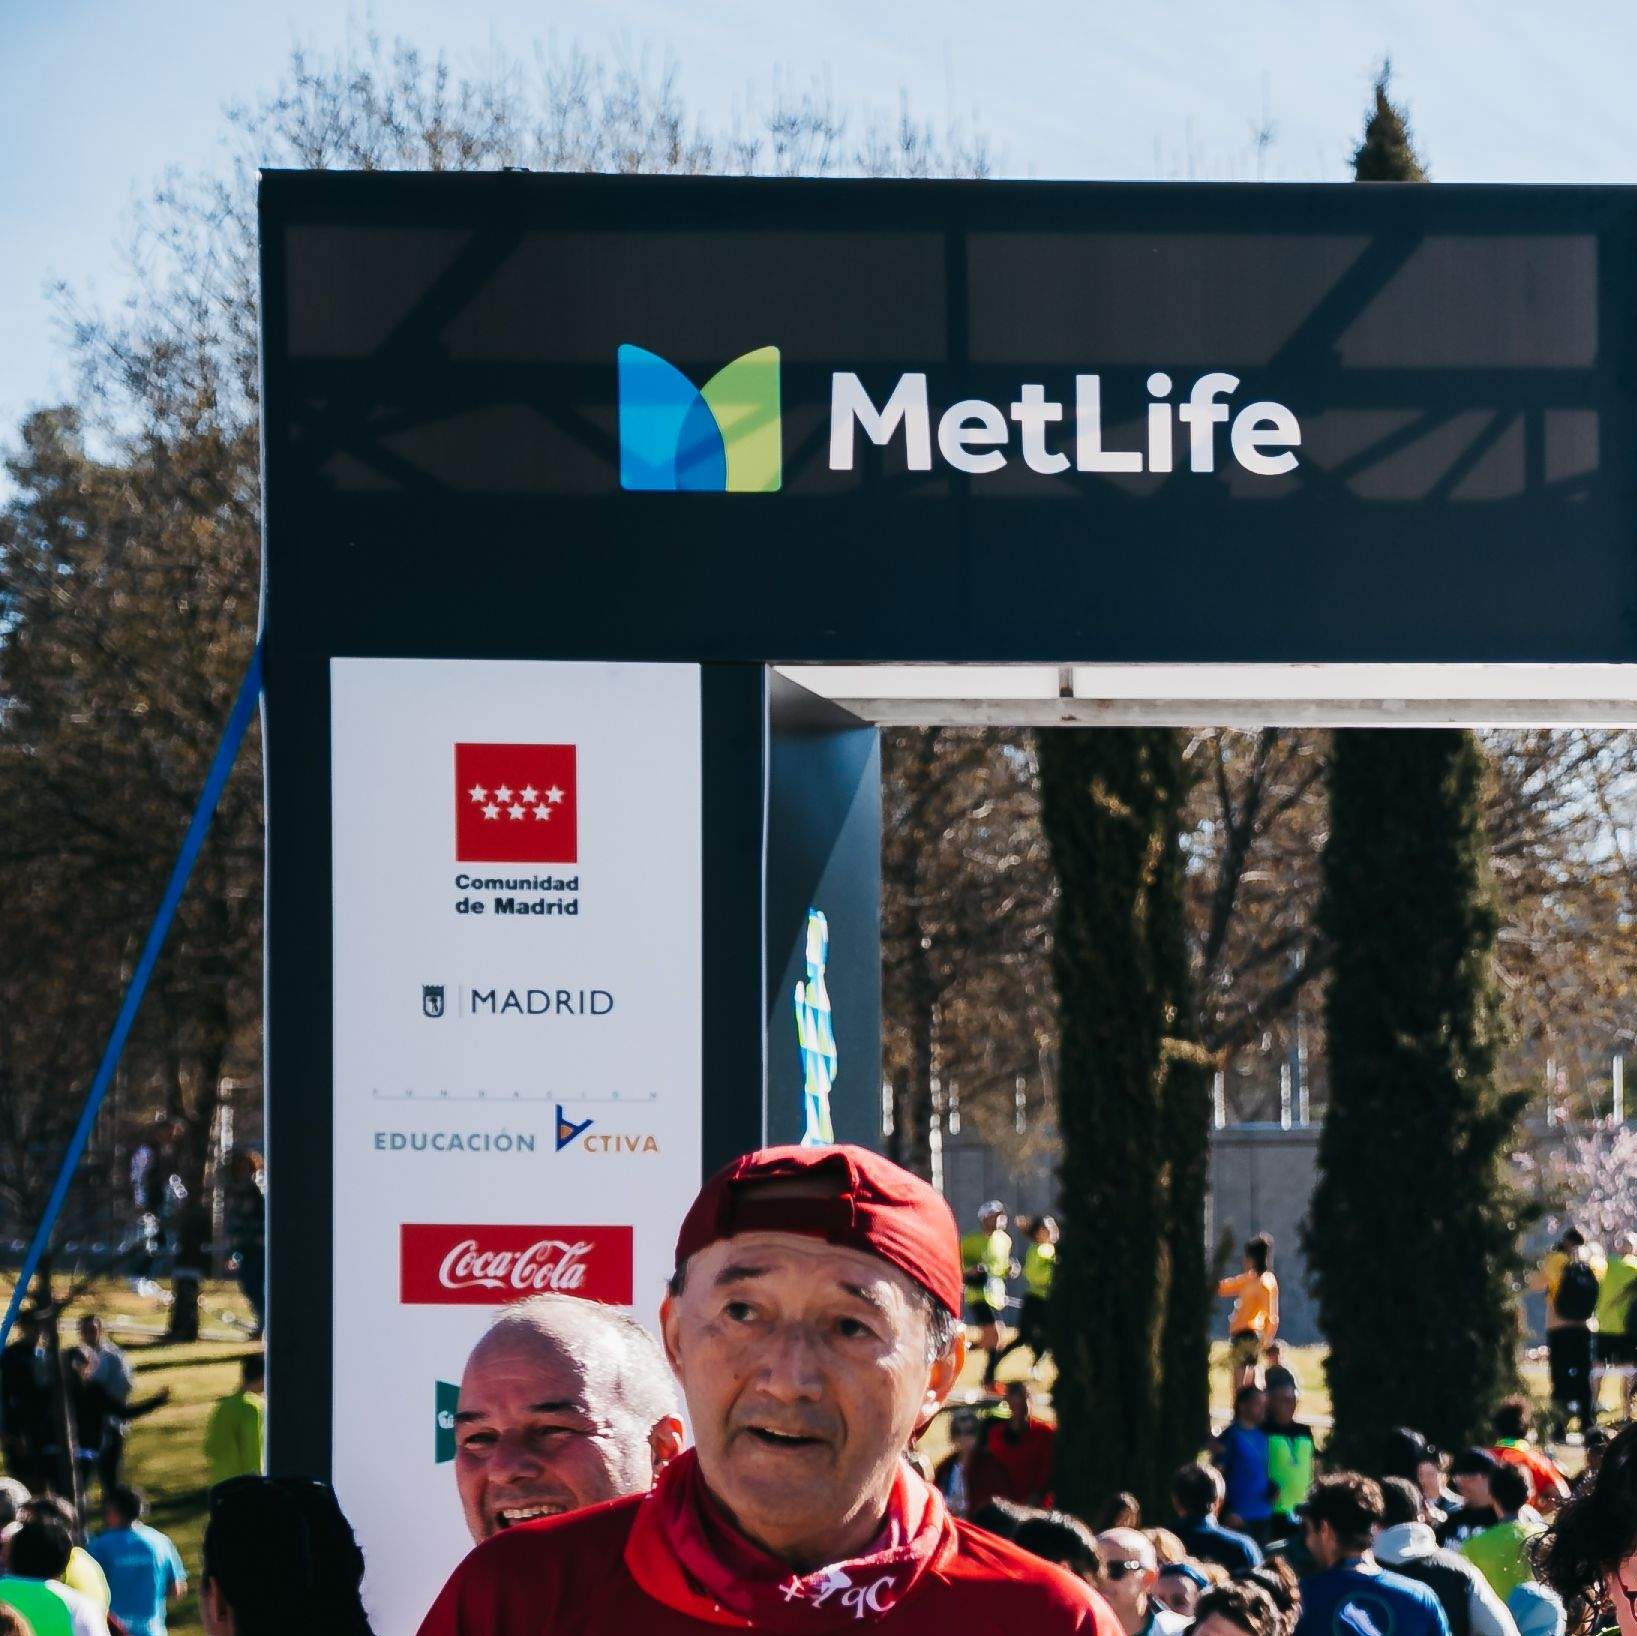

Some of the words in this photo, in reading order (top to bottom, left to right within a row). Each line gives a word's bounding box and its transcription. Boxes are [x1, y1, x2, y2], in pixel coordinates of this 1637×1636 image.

[828, 370, 1302, 476] MetLife
[454, 873, 580, 892] Comunidad
[454, 897, 485, 915] de
[494, 897, 580, 916] Madrid
[470, 989, 615, 1016] MADRID
[373, 1128, 536, 1153] EDUCACIÓN
